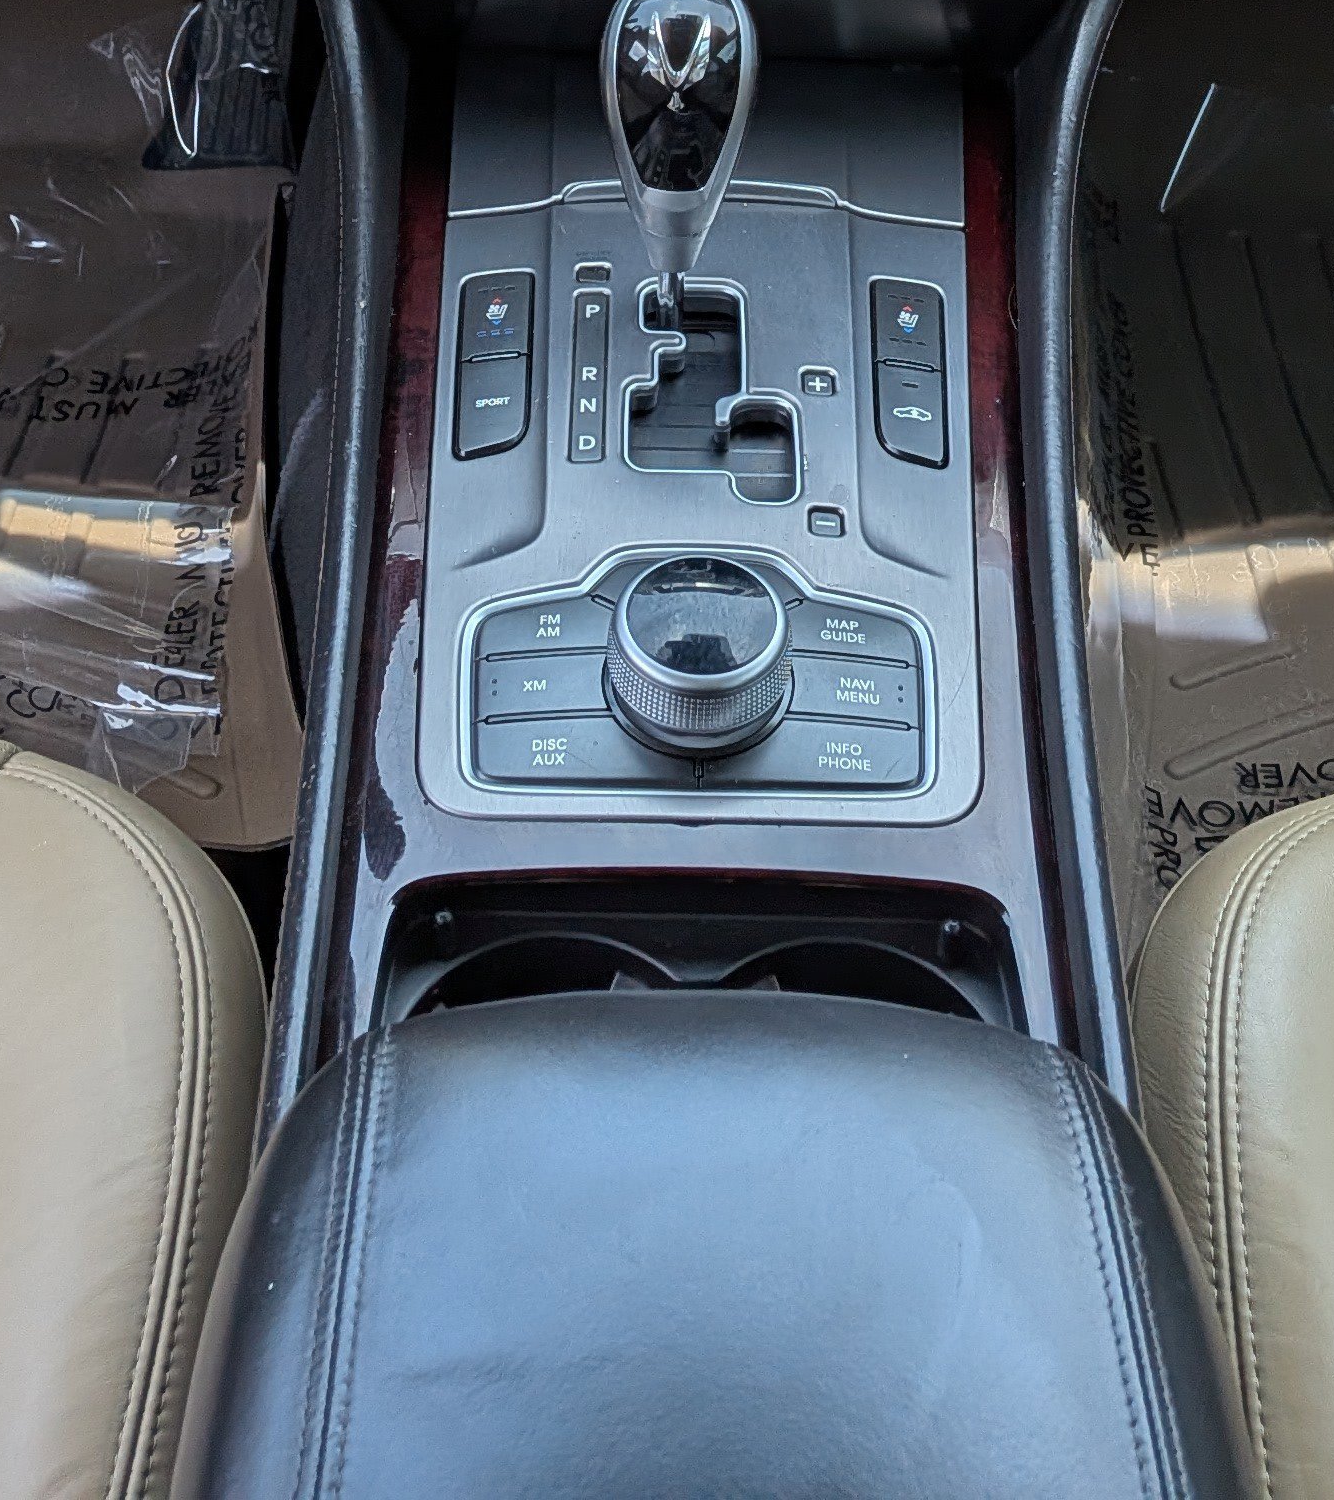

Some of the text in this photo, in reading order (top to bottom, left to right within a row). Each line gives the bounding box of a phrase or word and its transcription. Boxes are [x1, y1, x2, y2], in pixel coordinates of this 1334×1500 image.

[585, 304, 600, 319] P
[582, 366, 597, 382] R
[474, 394, 511, 410] SPORT
[579, 398, 597, 413] N
[578, 435, 596, 451] D
[538, 613, 562, 626] FM
[825, 617, 860, 632] MAP
[535, 625, 561, 639] AM
[819, 630, 867, 645] GUIDE
[522, 679, 548, 693] XM
[839, 677, 876, 692] NAVI
[835, 690, 881, 705] MENU
[530, 737, 568, 752] DISC
[825, 741, 863, 757] INFO
[531, 751, 566, 767] AUX
[816, 755, 873, 772] PHONE
